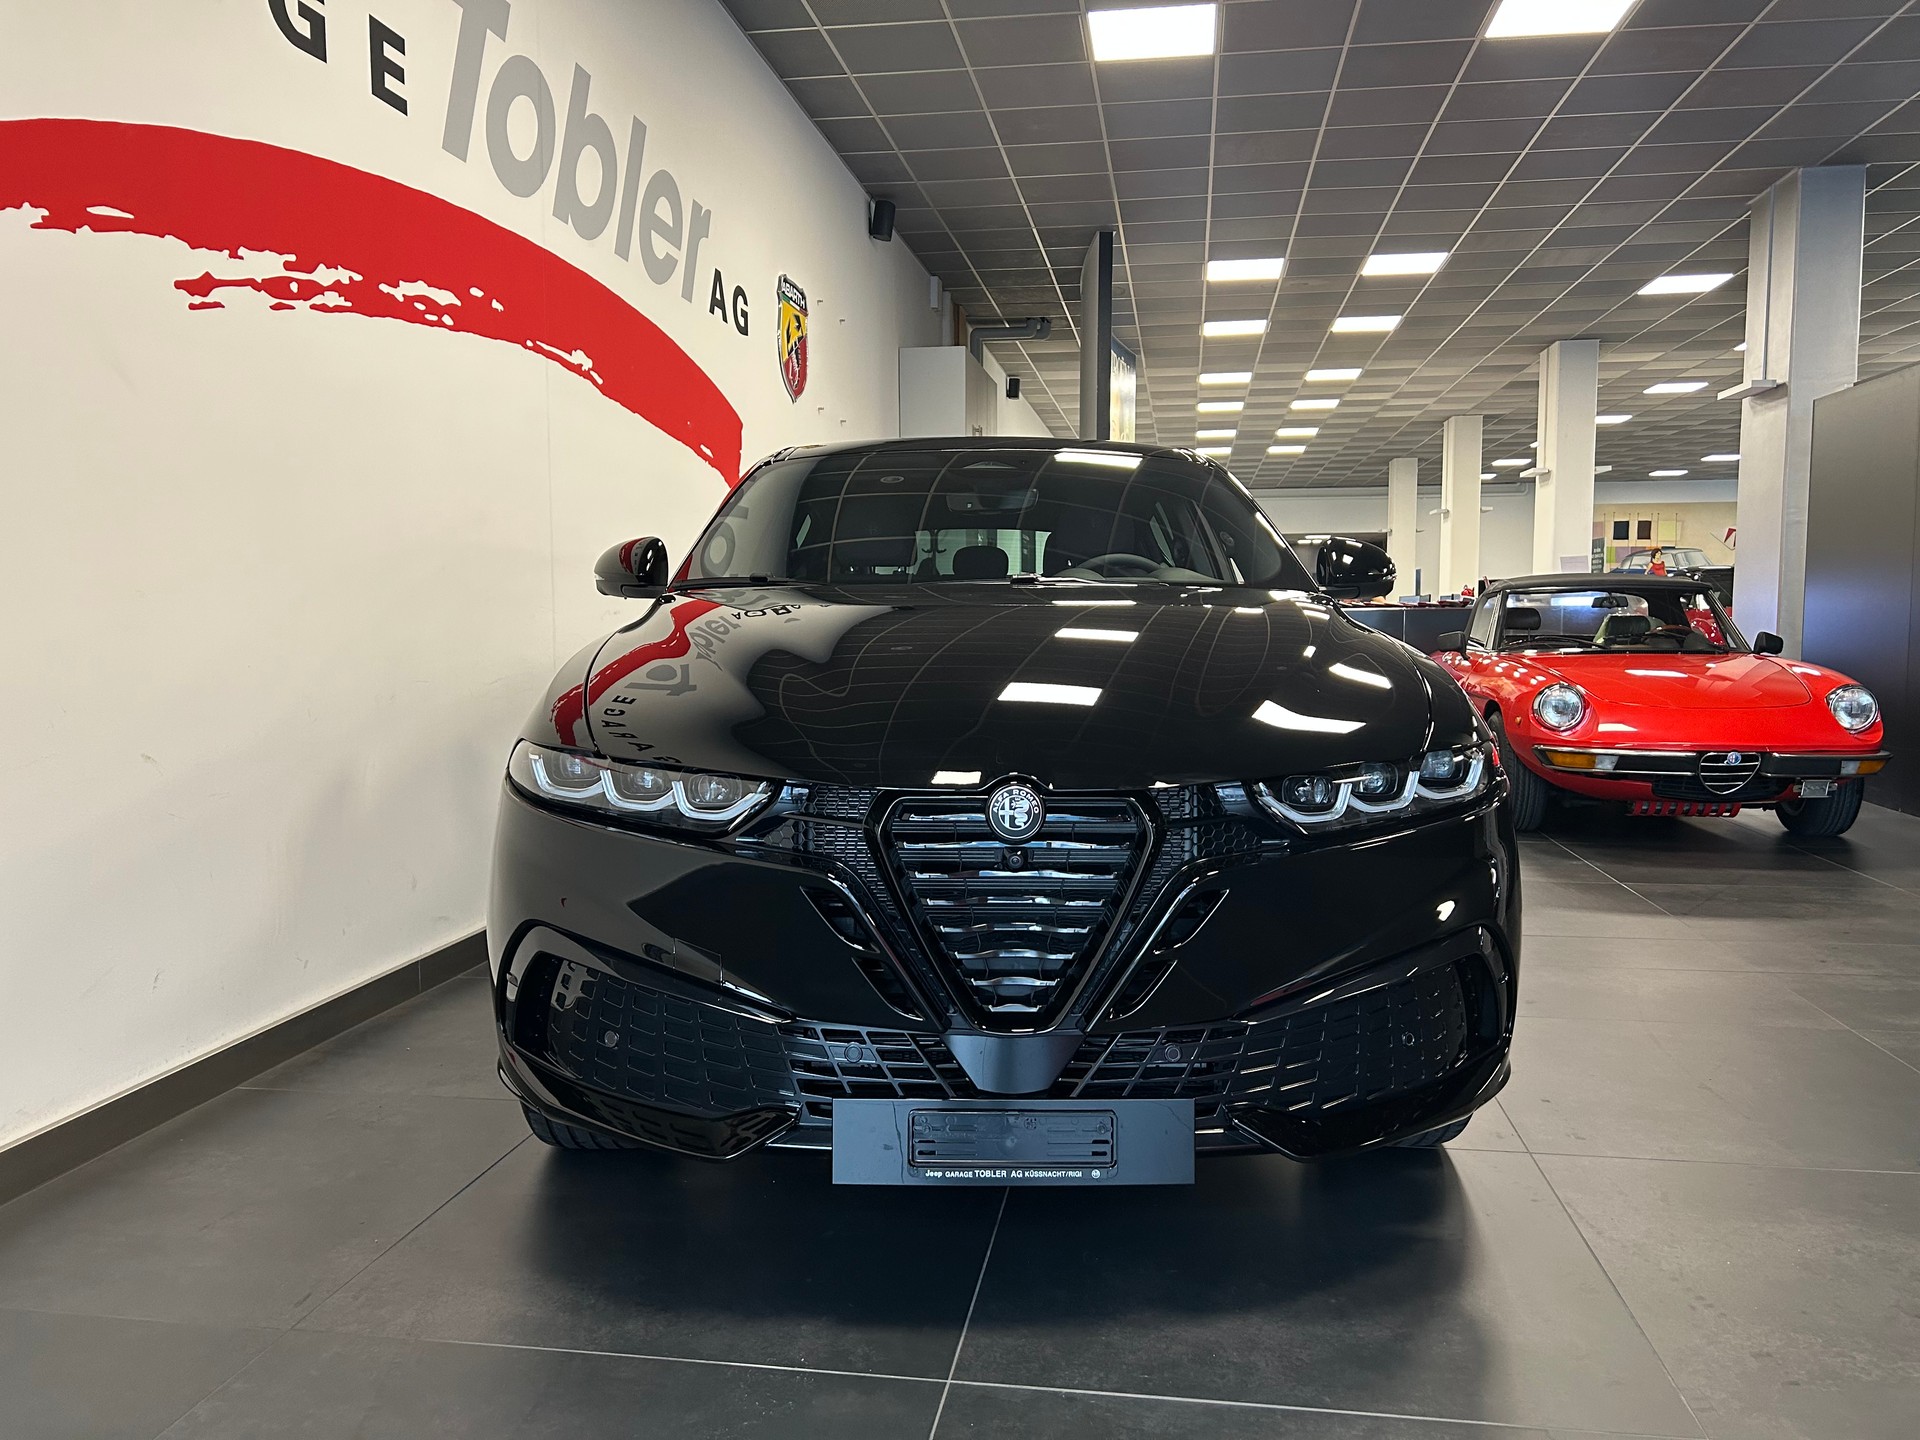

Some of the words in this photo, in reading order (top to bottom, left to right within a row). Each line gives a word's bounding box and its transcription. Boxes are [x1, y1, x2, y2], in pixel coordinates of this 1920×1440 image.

[441, 0, 712, 304] Tobler
[709, 268, 750, 337] AG
[781, 282, 805, 309] ABARTH
[993, 792, 1010, 813] ALFA
[1012, 789, 1039, 814] ROMEO
[925, 1169, 943, 1178] Jeep
[945, 1170, 973, 1178] GARAGE
[974, 1169, 1007, 1178] TOBLER
[1010, 1169, 1023, 1178] AG
